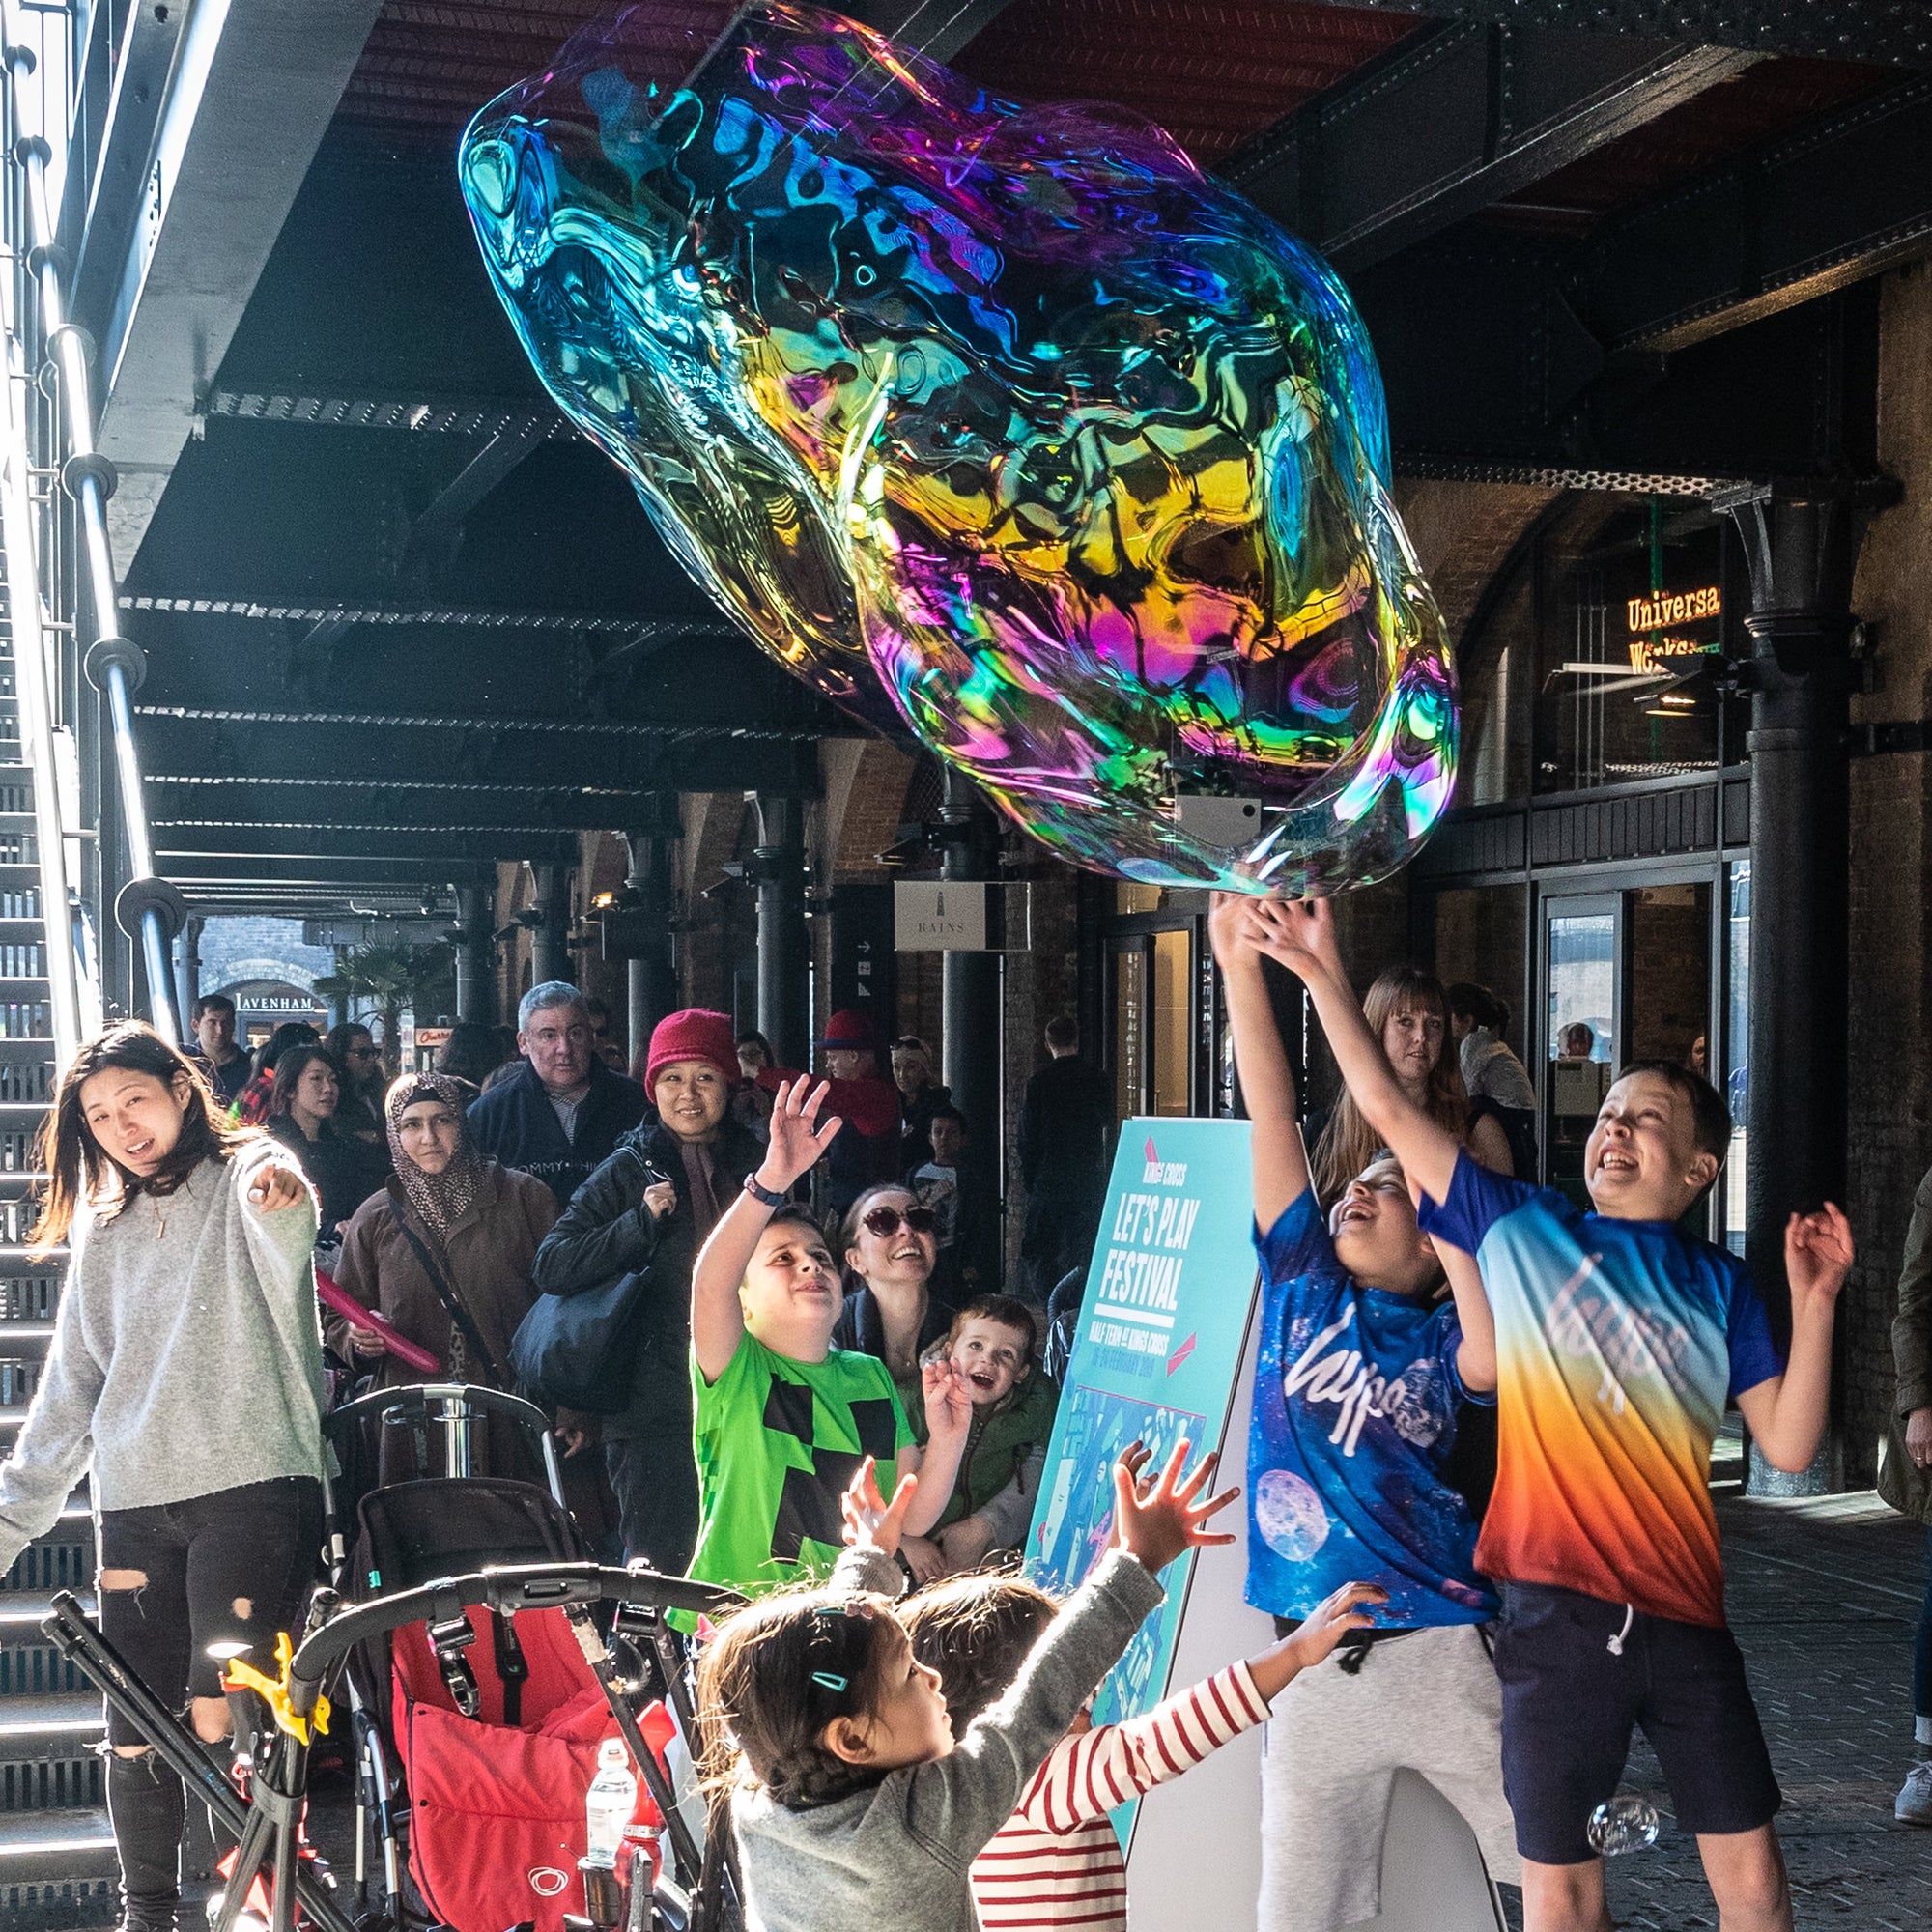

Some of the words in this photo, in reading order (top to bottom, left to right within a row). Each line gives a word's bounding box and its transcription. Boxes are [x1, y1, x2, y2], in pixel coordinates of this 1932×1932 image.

[918, 923, 964, 933] RAINS
[235, 992, 315, 1012] LAVENHAM
[512, 1159, 564, 1174] OMMY
[1112, 1192, 1159, 1245] LET'S
[1154, 1197, 1201, 1251] PLAY
[1098, 1249, 1183, 1312] FESTIVAL
[1089, 1321, 1106, 1343] HALF
[1104, 1324, 1123, 1347] TERM
[1147, 1332, 1170, 1357] CROSS
